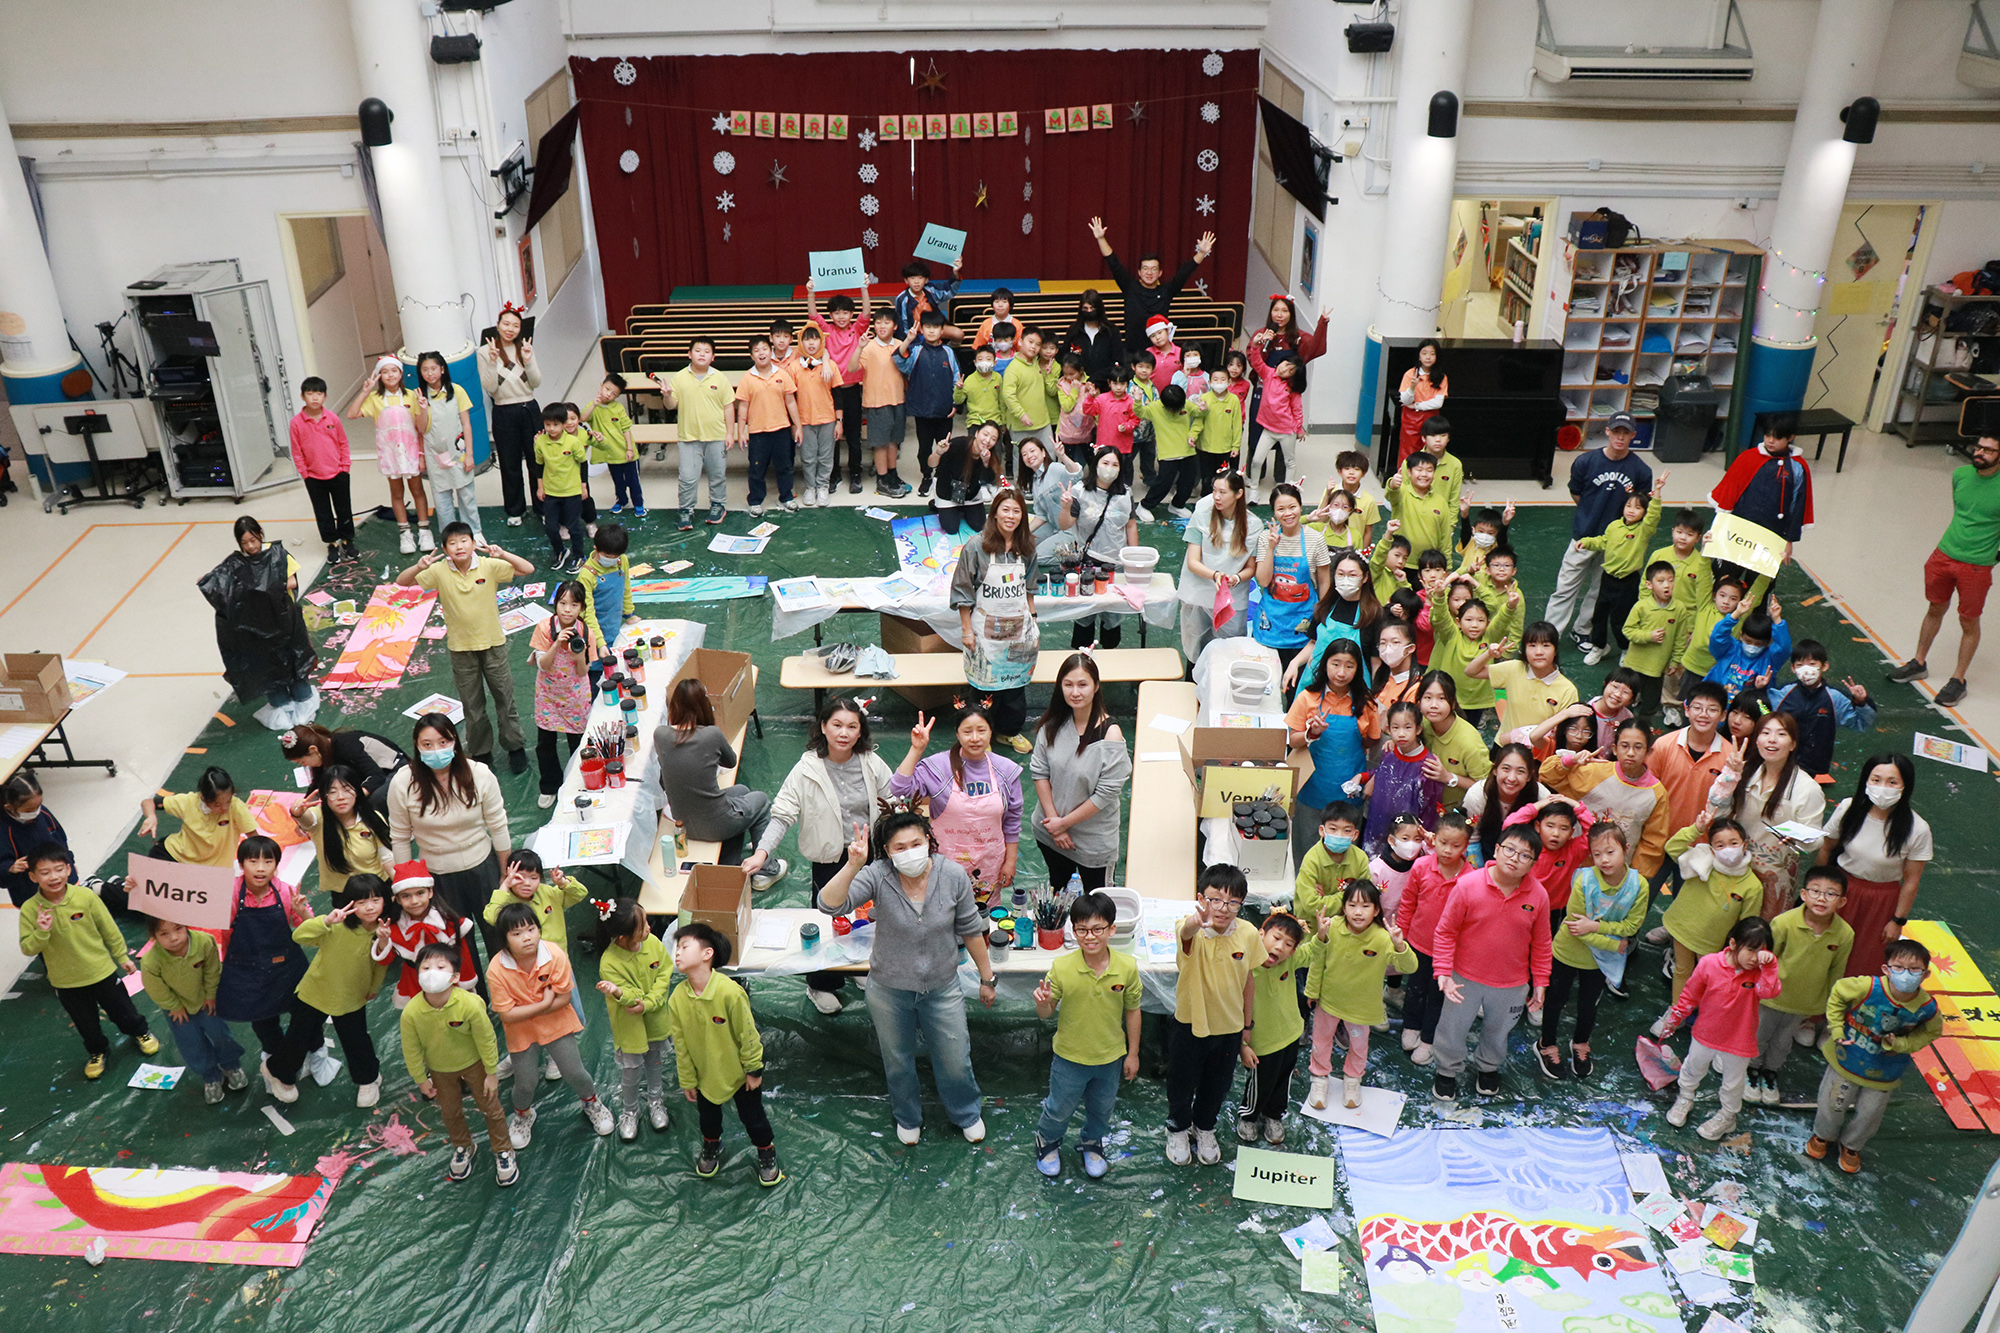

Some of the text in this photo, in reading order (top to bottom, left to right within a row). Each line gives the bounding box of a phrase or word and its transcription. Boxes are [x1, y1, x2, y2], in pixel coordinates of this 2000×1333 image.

[735, 110, 1107, 134] MERRY CHRIST MAS
[927, 236, 958, 252] Uranus
[817, 265, 857, 277] Uranus
[1727, 530, 1769, 556] Ven
[1220, 790, 1272, 803] Venu
[145, 879, 208, 905] Mars
[1250, 1166, 1317, 1185] Jupiter
